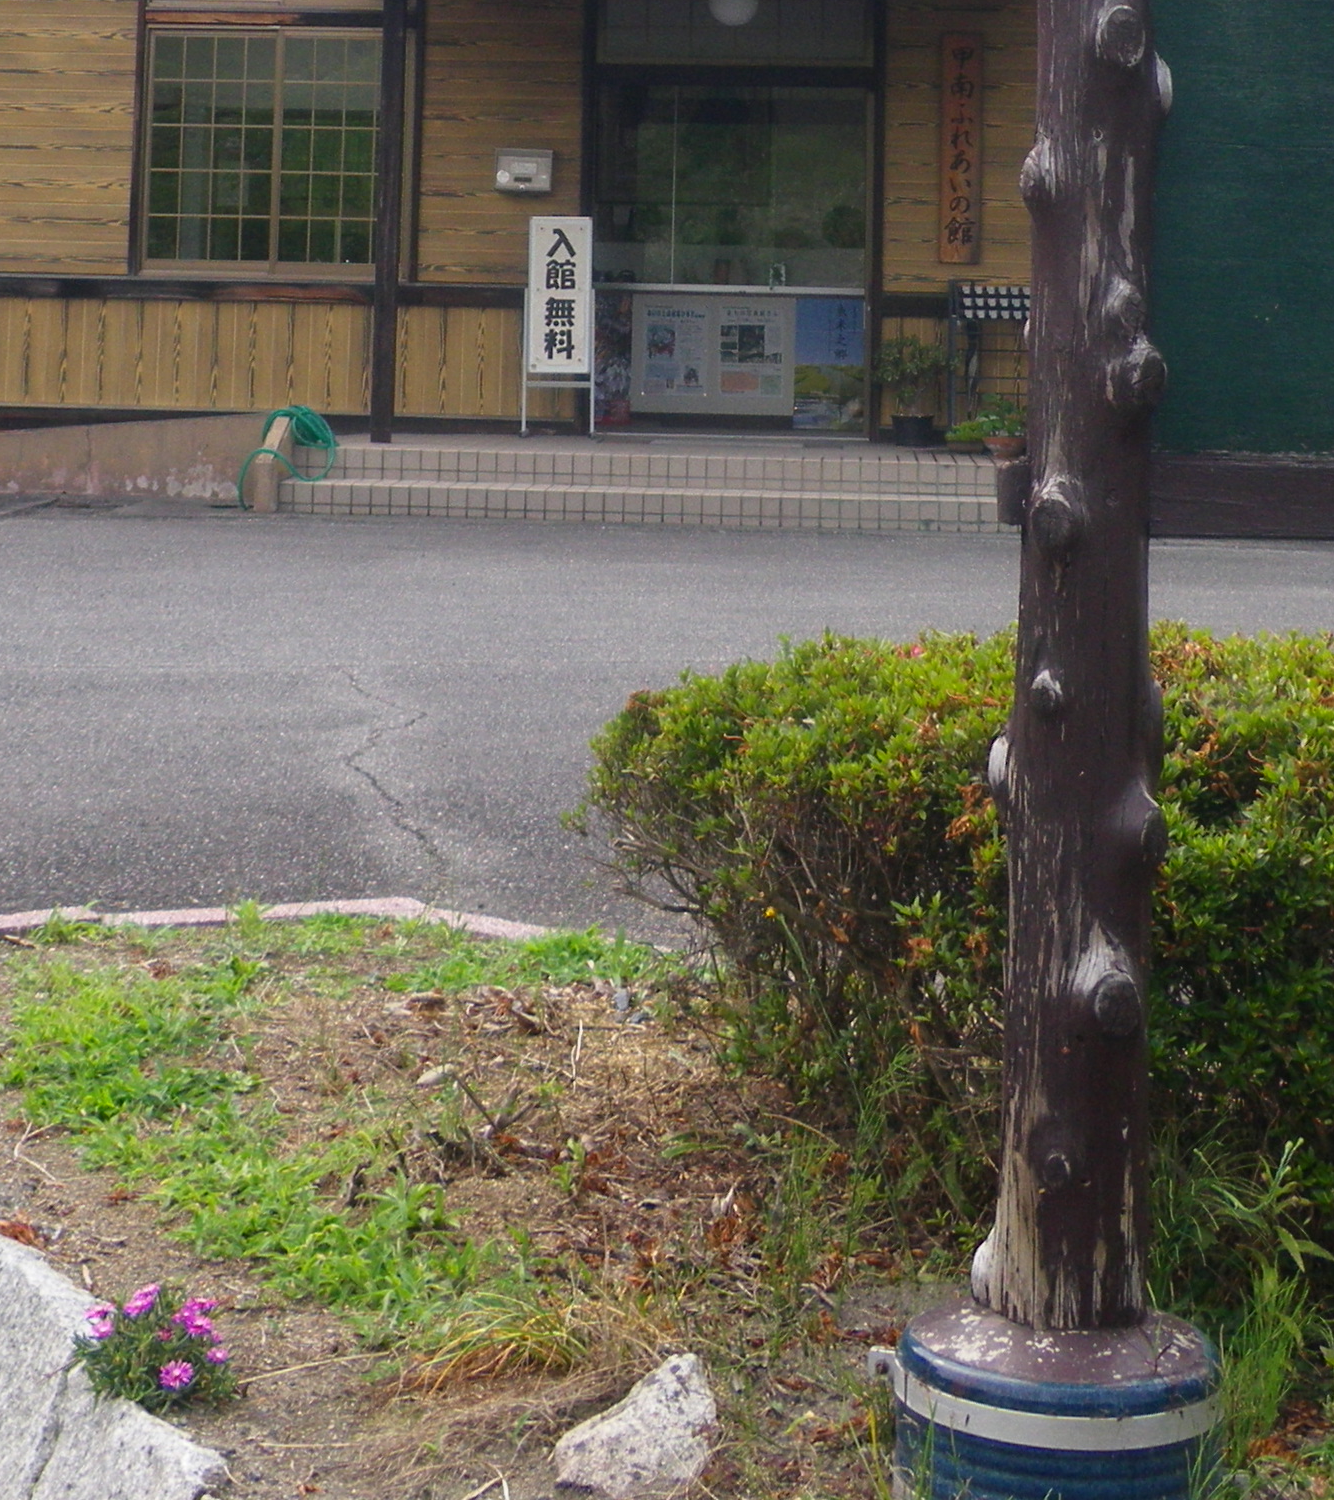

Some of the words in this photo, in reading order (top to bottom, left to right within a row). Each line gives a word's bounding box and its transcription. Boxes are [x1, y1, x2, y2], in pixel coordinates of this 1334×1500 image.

[943, 46, 976, 246] 甲南ふれあいの館
[543, 227, 577, 360] 入館無料
